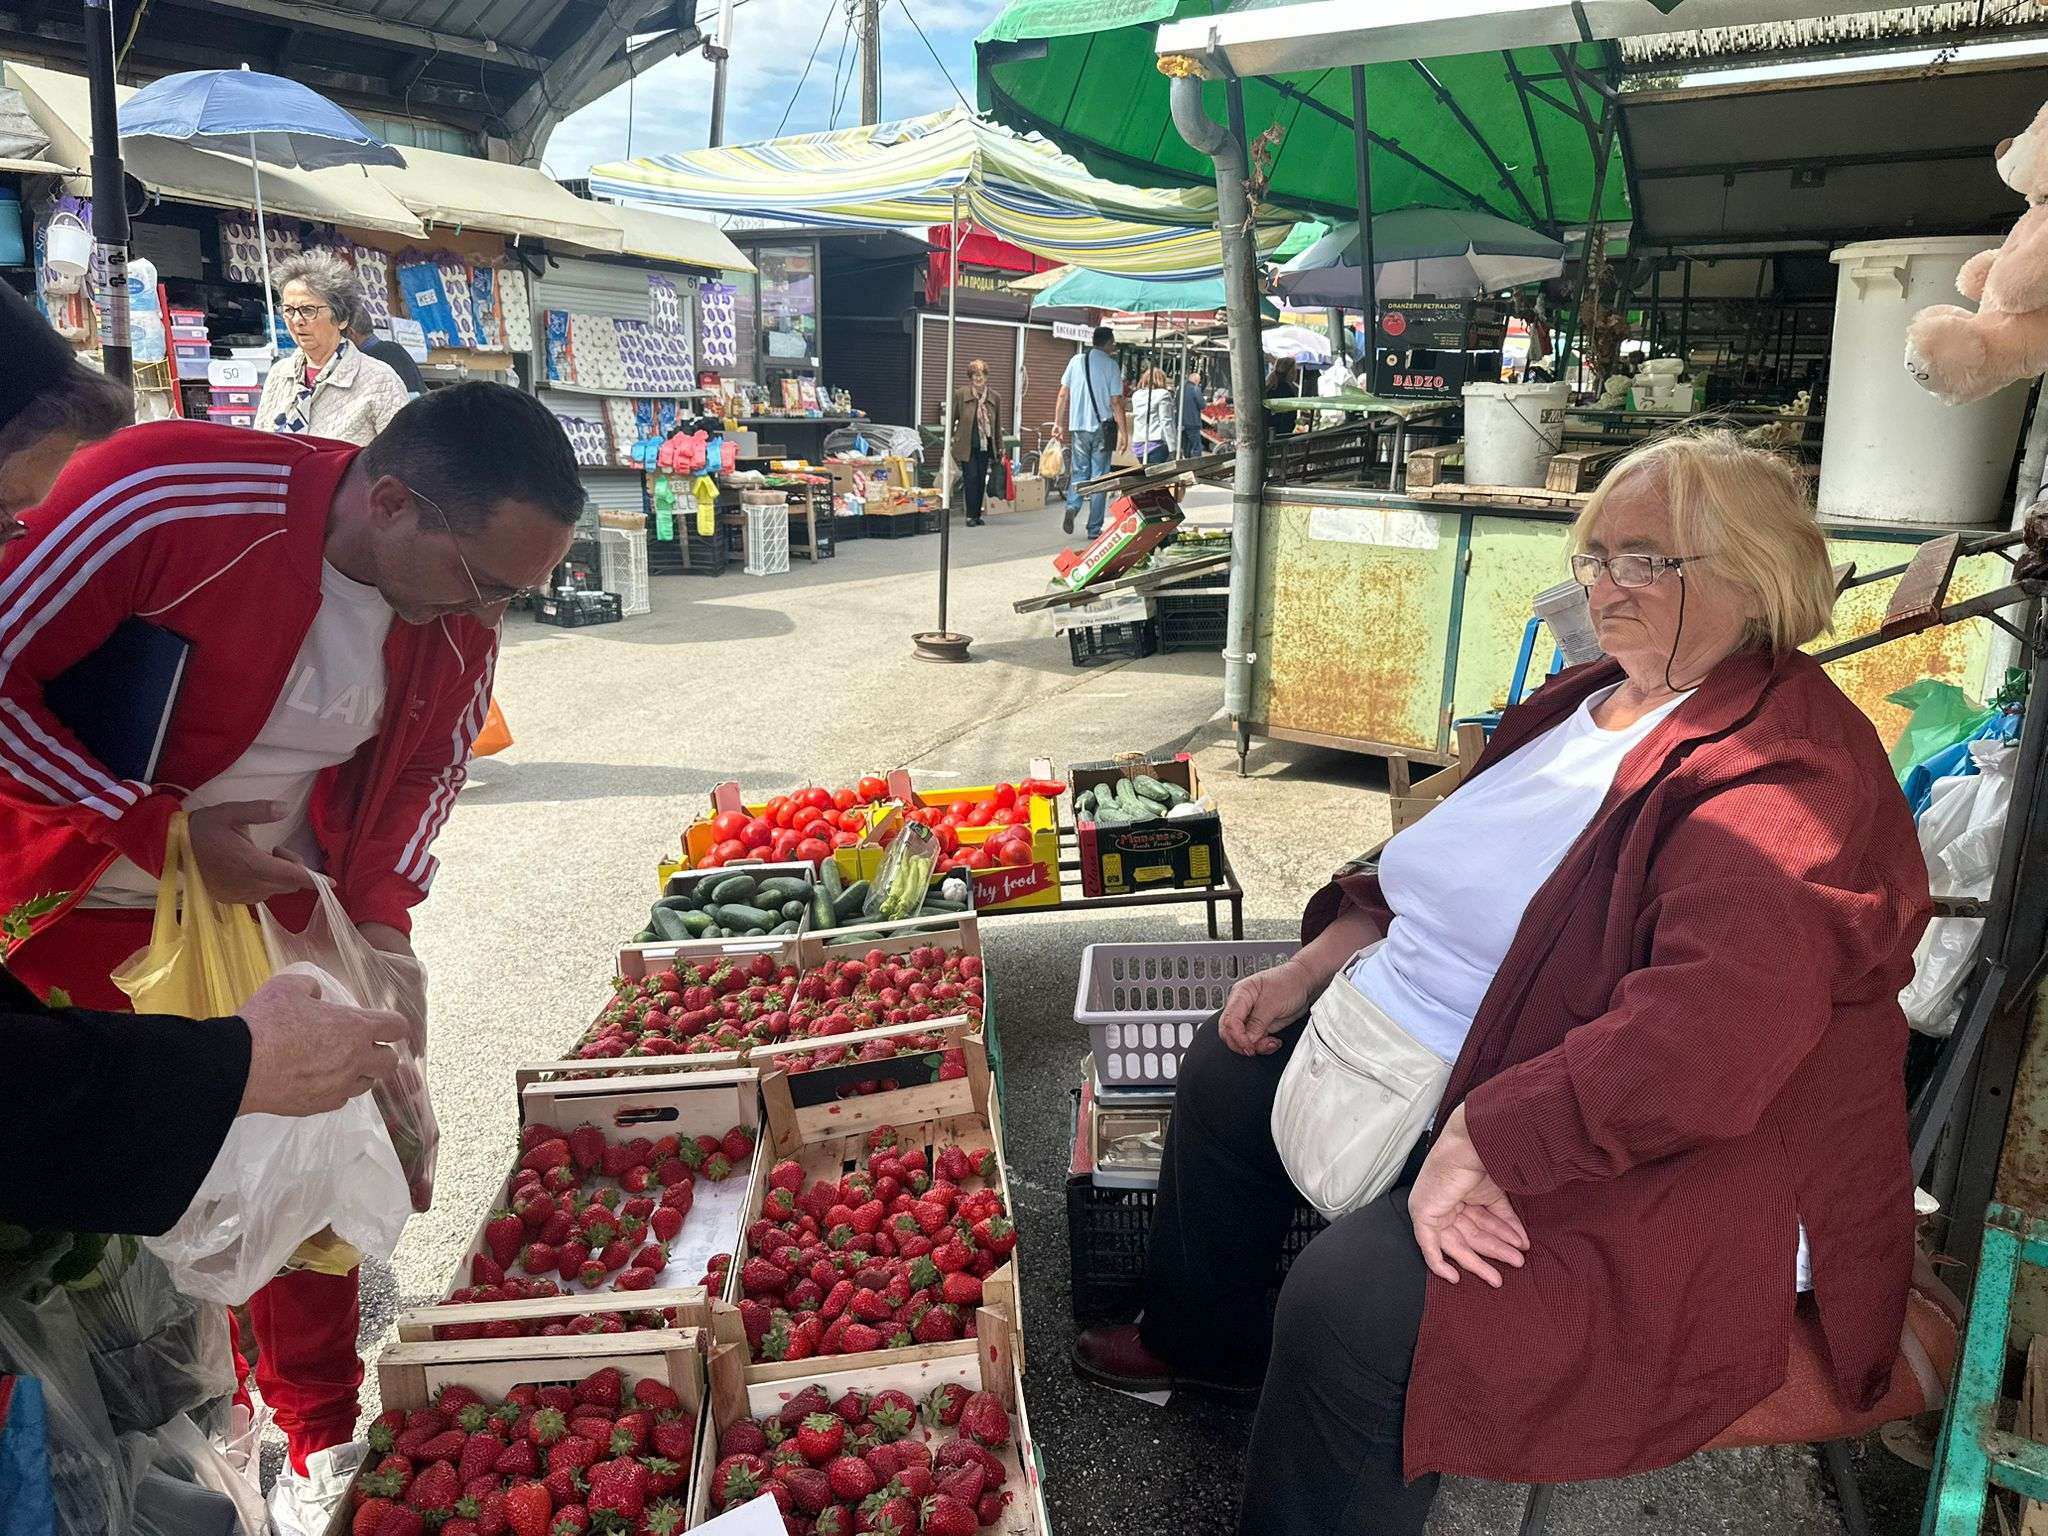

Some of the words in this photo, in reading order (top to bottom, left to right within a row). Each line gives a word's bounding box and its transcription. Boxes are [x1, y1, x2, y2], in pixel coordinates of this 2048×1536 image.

[688, 275, 698, 289] 61
[223, 367, 240, 380] 50
[1392, 374, 1444, 388] BADZO
[1086, 532, 1122, 570] Domati
[1003, 869, 1037, 898] food
